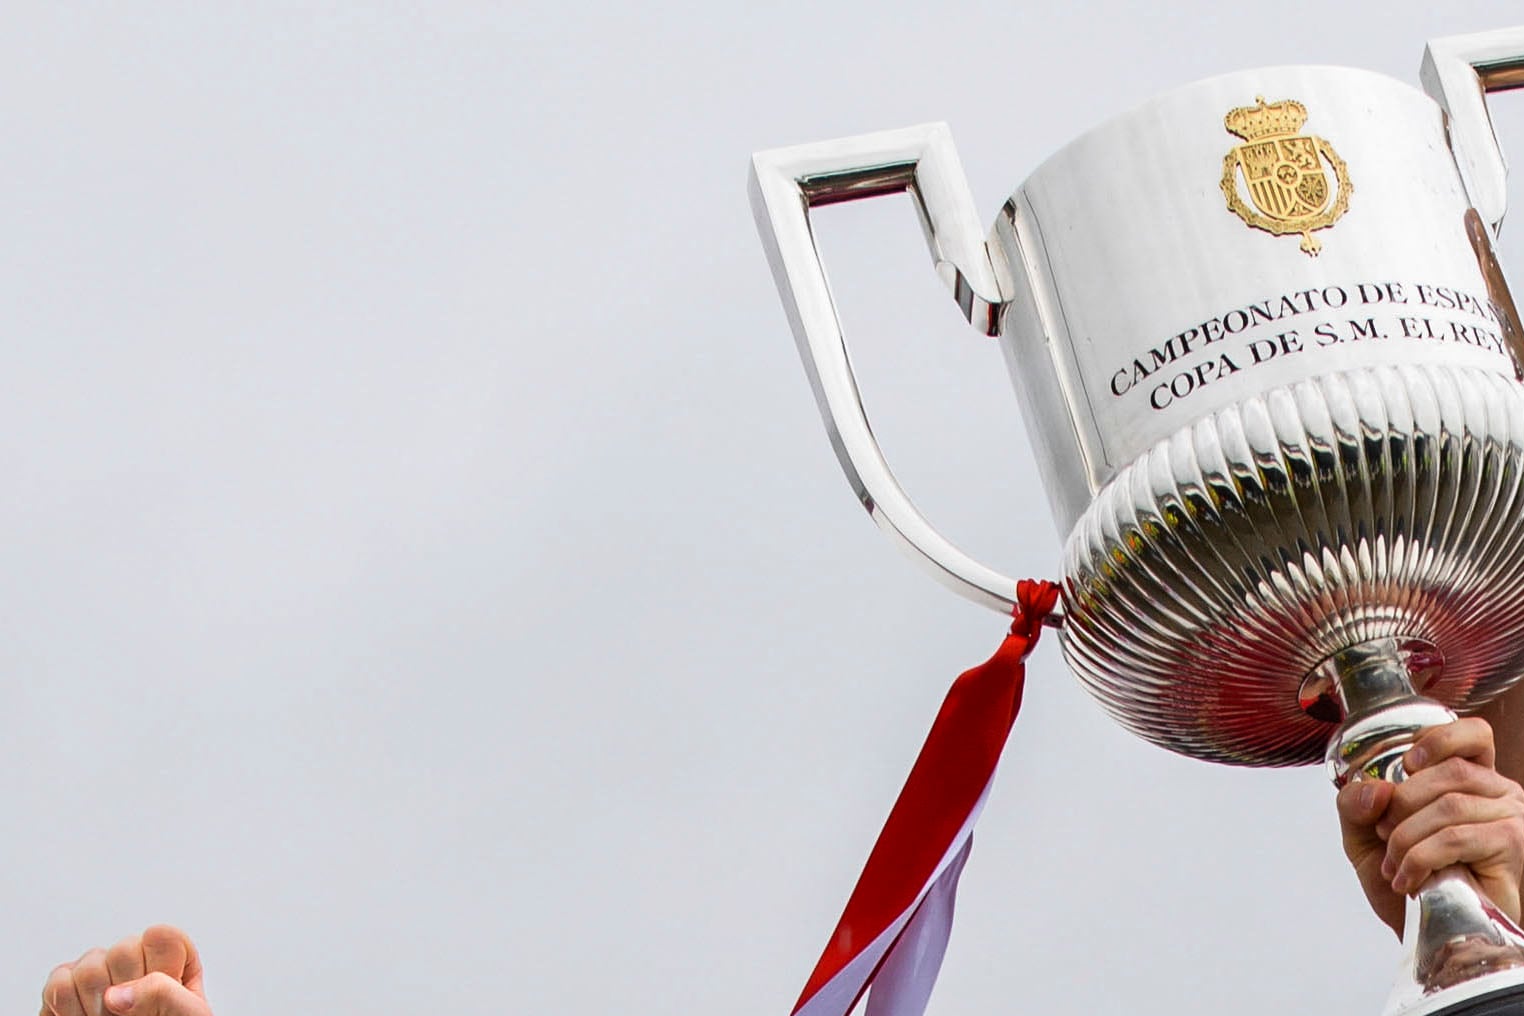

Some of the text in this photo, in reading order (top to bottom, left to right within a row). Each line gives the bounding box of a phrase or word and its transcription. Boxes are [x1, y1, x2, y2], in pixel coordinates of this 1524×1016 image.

[1110, 286, 1348, 397] CAMPEONATO
[1356, 283, 1409, 305] DE
[1150, 353, 1242, 410] COPA
[1248, 330, 1304, 366] DE
[1399, 317, 1445, 343] EL
[1450, 321, 1505, 355] REY
